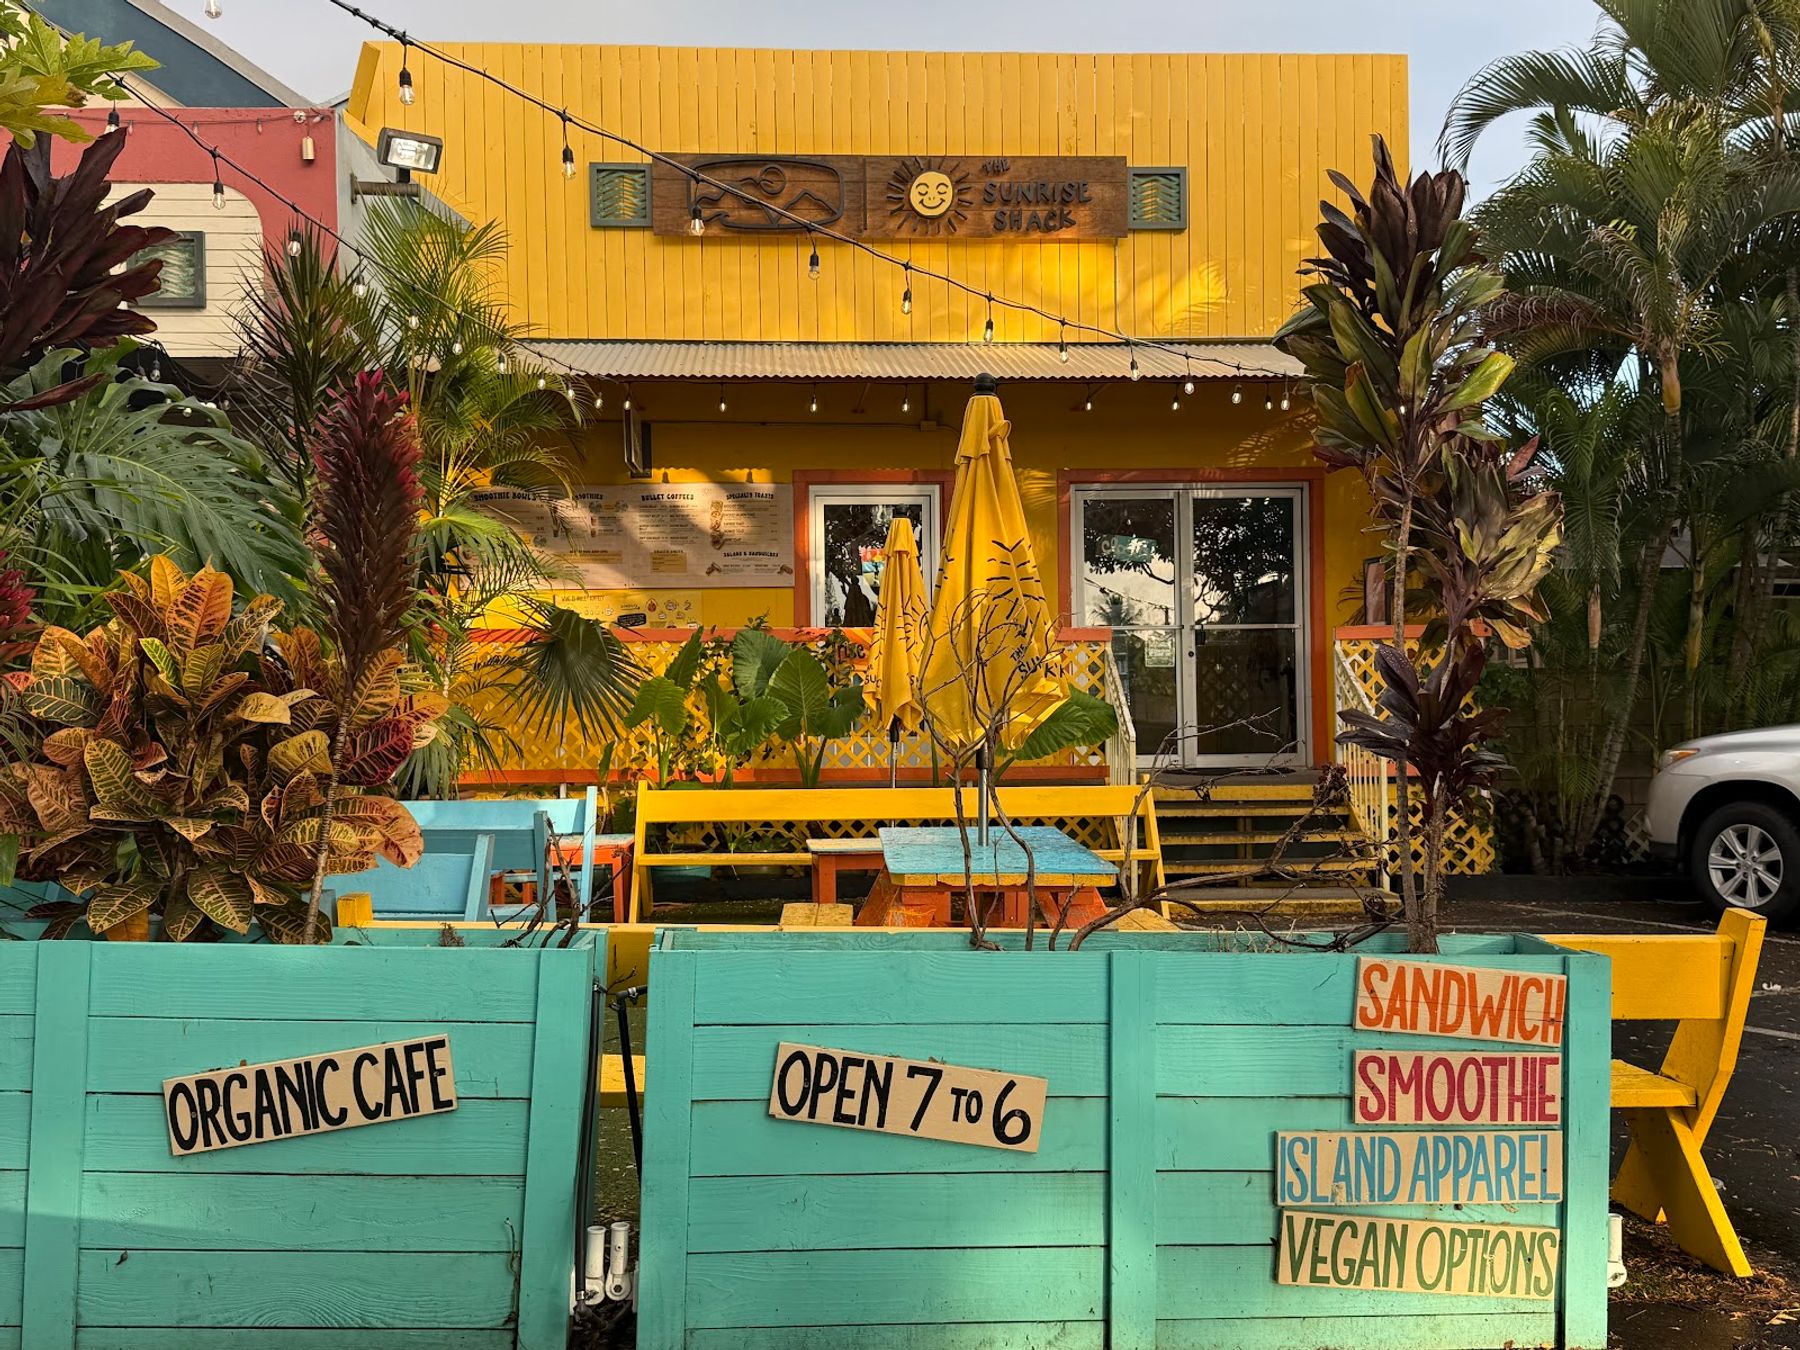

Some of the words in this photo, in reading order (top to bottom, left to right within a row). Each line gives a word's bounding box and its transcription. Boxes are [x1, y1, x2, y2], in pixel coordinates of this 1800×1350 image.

[982, 159, 1010, 175] THE
[983, 180, 1092, 203] SUNRISE
[993, 207, 1077, 233] SHACK
[512, 491, 537, 502] BOWLS
[640, 493, 665, 502] BULLET
[666, 492, 695, 501] COFFEES
[1359, 963, 1565, 1044] SANDWICH
[169, 1058, 348, 1151] ORGANIC
[353, 1039, 454, 1120] CAFE
[777, 1050, 893, 1128] OPEN
[907, 1065, 943, 1132] 7
[951, 1087, 983, 1124] TO
[992, 1079, 1031, 1145] 6
[1358, 1055, 1559, 1122] SMOOTHIE
[1280, 1135, 1401, 1203] ISLAND
[1408, 1134, 1560, 1201] APPAREL
[1286, 1215, 1409, 1288] VEGAN
[1416, 1226, 1557, 1297] OPTIONS
